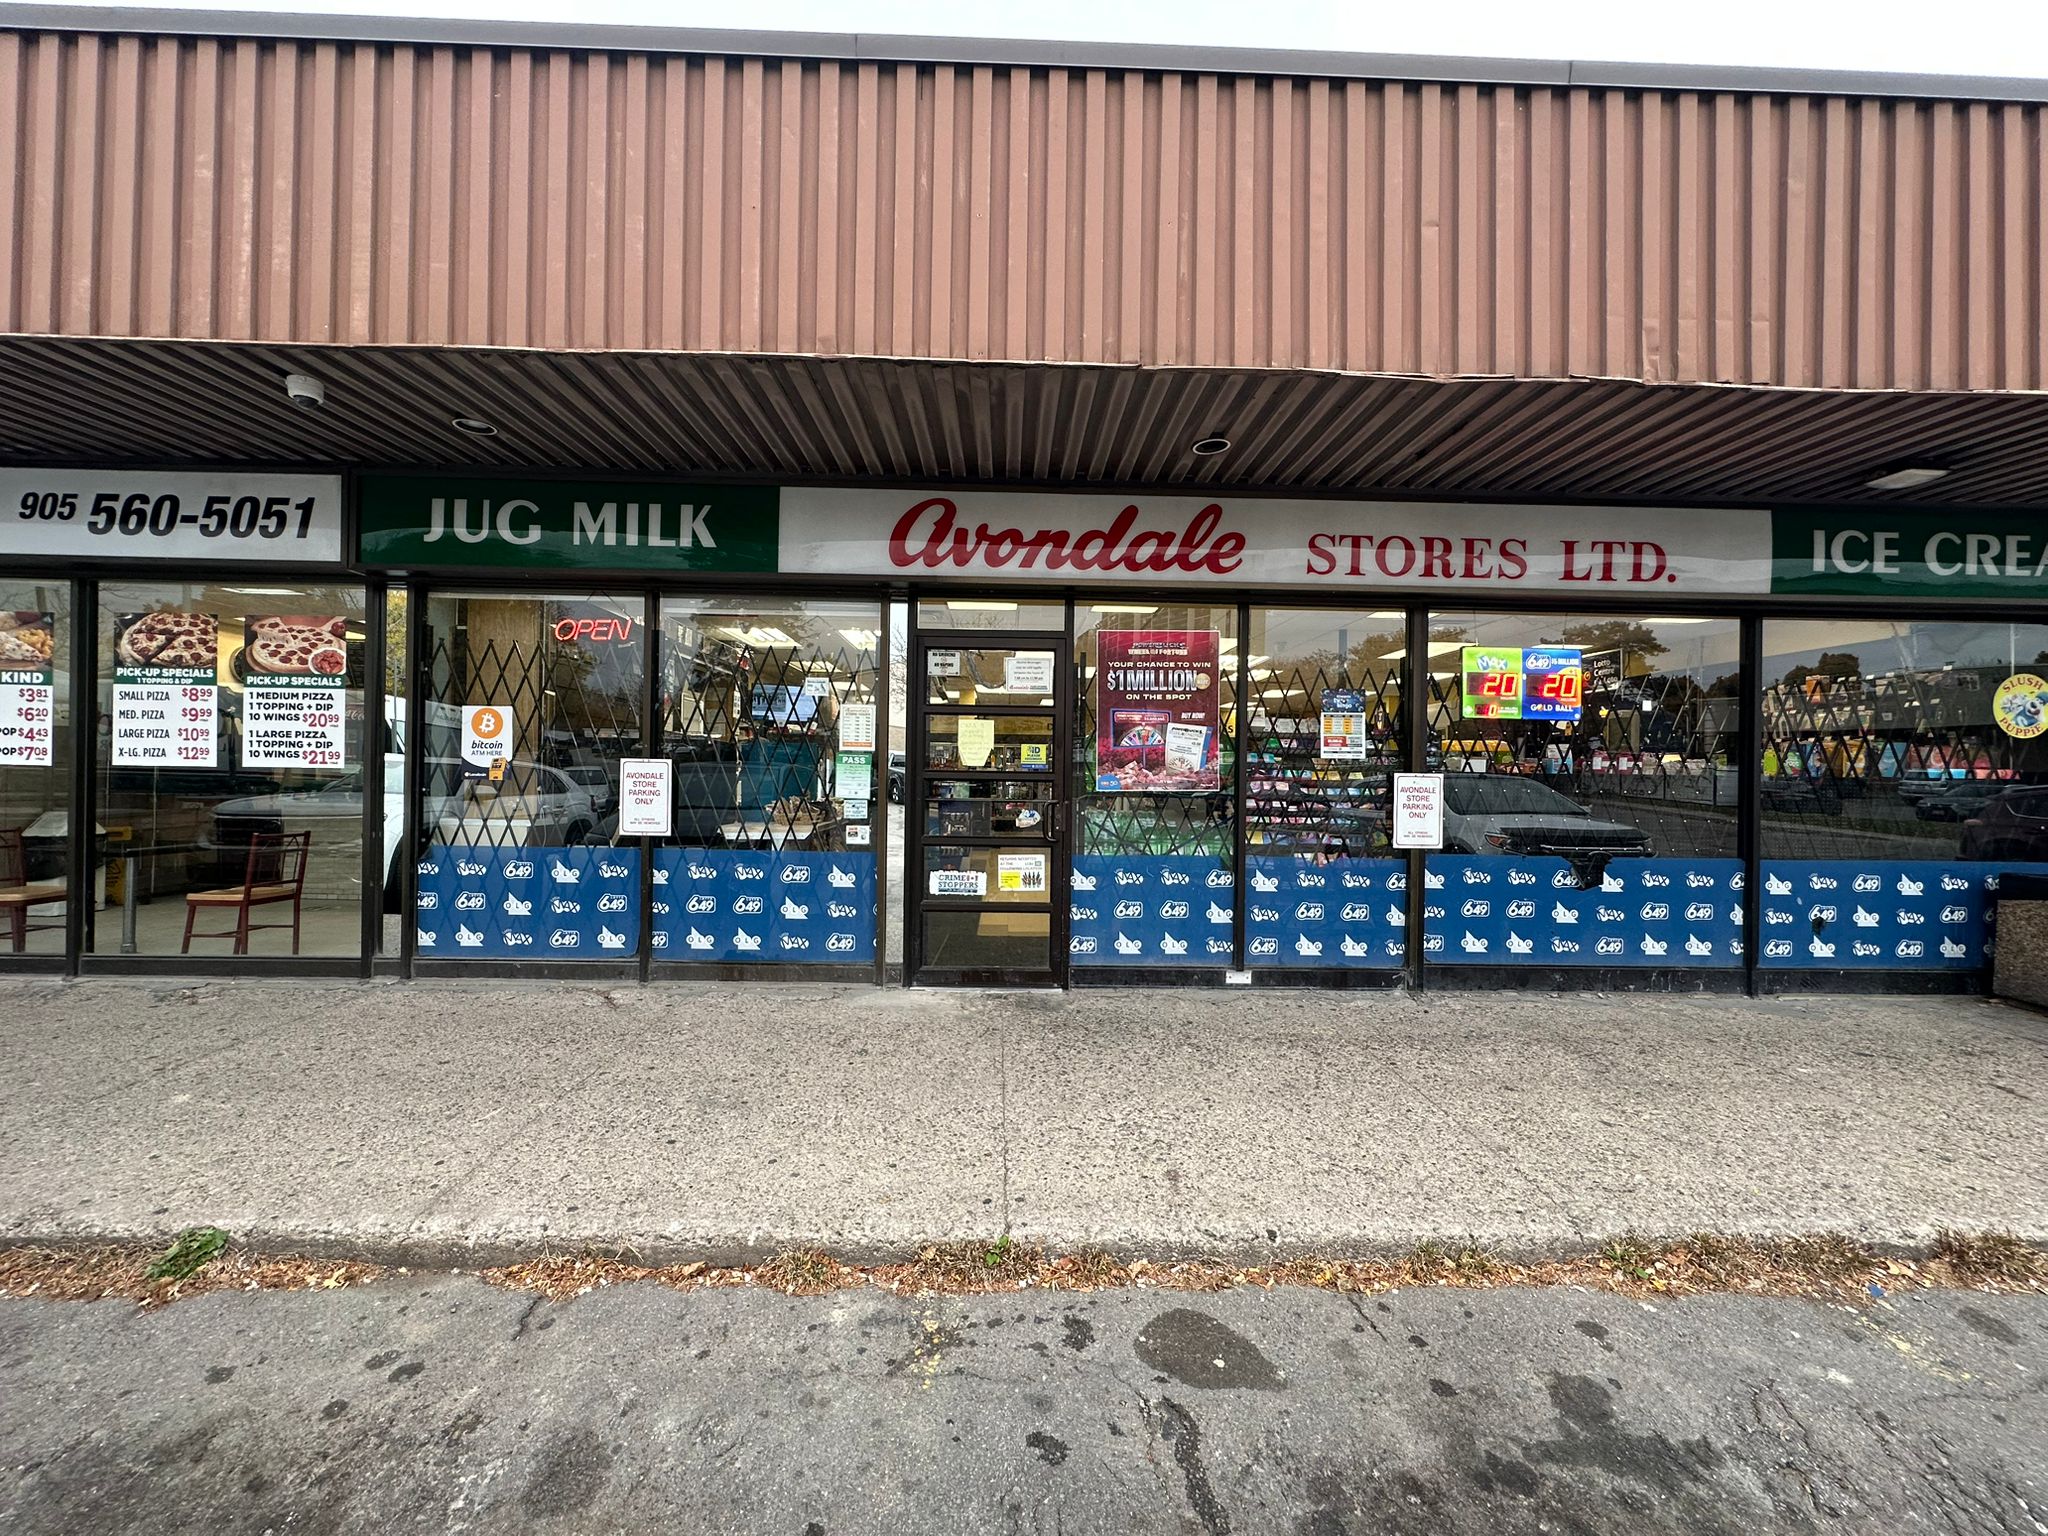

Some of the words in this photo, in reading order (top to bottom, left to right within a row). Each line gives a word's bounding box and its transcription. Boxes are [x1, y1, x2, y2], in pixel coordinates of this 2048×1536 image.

[19, 492, 78, 520] 905
[87, 493, 316, 538] 560-5051
[424, 498, 542, 545] JUG
[573, 502, 717, 548] MILK
[888, 497, 1247, 575] Avondale
[1306, 533, 1528, 580] STORES
[1558, 539, 1677, 583] LTD.
[1813, 530, 1900, 573] ICE
[555, 617, 632, 641] OPEN
[1527, 654, 1551, 668] 649
[1593, 660, 1610, 668] Lotto
[1, 672, 44, 683] KIND
[117, 668, 160, 677] PICK-UP
[162, 669, 213, 678] SPECIALS
[247, 676, 289, 685] PICK-UP
[291, 677, 342, 686] SPECIALS
[1127, 669, 1198, 691] MILLION
[1484, 674, 1518, 696] 20
[1543, 674, 1577, 697] 20
[2003, 677, 2044, 693] SLUSH
[119, 691, 144, 700] SMALL
[147, 692, 170, 700] PIZZA
[256, 692, 299, 700] MEDIUM
[302, 693, 334, 701] PIZZA
[249, 702, 253, 710] 1
[256, 702, 304, 710] TOPPING
[1530, 703, 1553, 711] GOLD
[1555, 704, 1574, 712] BALL
[119, 710, 139, 719] MED.
[142, 710, 165, 719] PIZZA
[263, 713, 300, 721] WINGS
[119, 729, 144, 738] LARGE
[147, 729, 170, 738] PIZZA
[256, 730, 292, 738] LARGE
[295, 731, 327, 739] PIZZA
[119, 748, 141, 757] X-LG.
[143, 748, 166, 757] PIZZA
[249, 740, 253, 748] 1
[256, 740, 303, 748] TOPPING
[316, 741, 333, 749] DIP
[472, 740, 503, 749] bitcoin
[249, 750, 260, 758] 10
[263, 750, 300, 758] WINGS
[505, 861, 532, 877] 649
[782, 866, 809, 882] 649
[828, 873, 855, 882] OLG
[1206, 870, 1233, 887] 649
[1853, 875, 1879, 891] 649
[1897, 881, 1924, 890] OLG
[457, 893, 484, 909] 649
[599, 896, 626, 911] 649
[687, 896, 715, 912] 649
[734, 896, 761, 913] 649
[1115, 901, 1142, 917] 649
[1161, 901, 1188, 917] 649
[1462, 900, 1489, 916] 649
[1507, 901, 1534, 917] 649
[1296, 903, 1323, 919] 649
[1341, 903, 1368, 920] 649
[1641, 903, 1668, 919] 649
[1686, 903, 1712, 919] 649
[1941, 906, 1966, 922] 649
[456, 933, 483, 941] OLG
[551, 930, 578, 946] 649
[598, 935, 625, 943] OLG
[827, 934, 854, 950] 649
[1160, 941, 1187, 949] OLG
[1461, 939, 1488, 947] OLG
[1250, 938, 1277, 954] 649
[1296, 942, 1322, 951] OLG
[1596, 938, 1622, 954] 649
[1685, 942, 1712, 950] OLG
[1765, 940, 1791, 956] 649
[1809, 943, 1835, 953] OLG
[1896, 941, 1922, 956] 649
[1940, 944, 1966, 953] OLG
